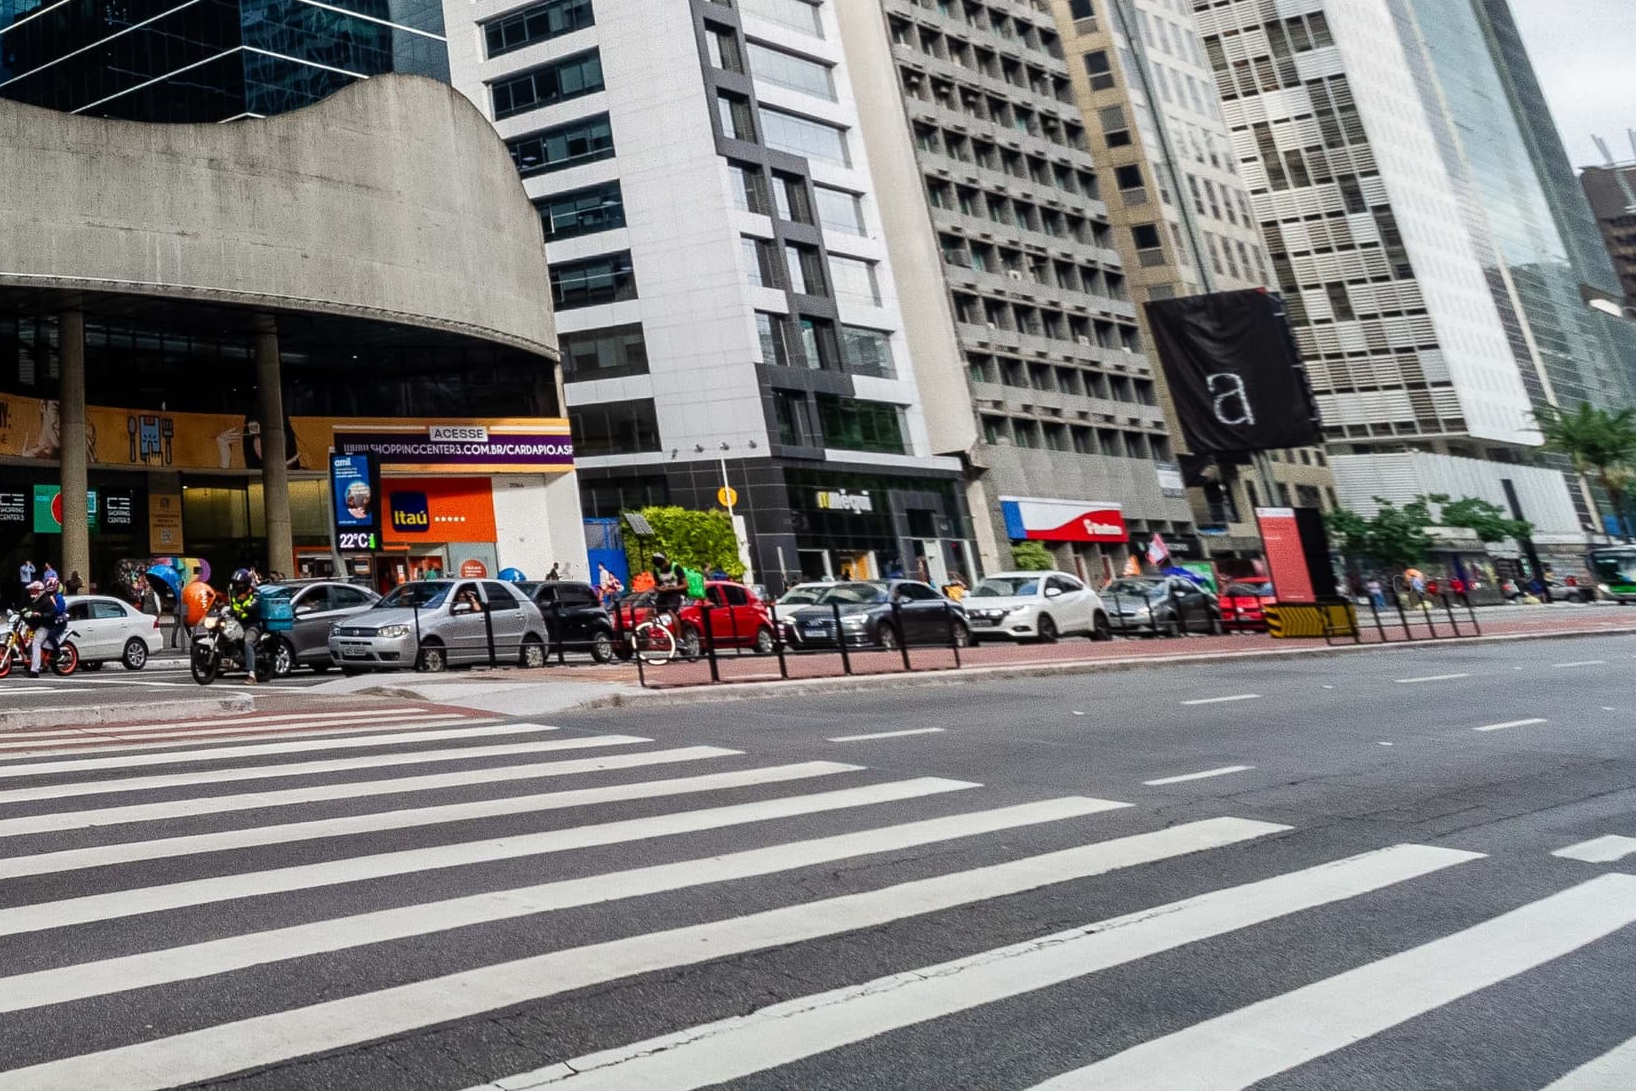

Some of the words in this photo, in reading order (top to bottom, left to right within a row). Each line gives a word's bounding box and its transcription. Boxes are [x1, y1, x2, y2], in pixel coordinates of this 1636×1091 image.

[1206, 372, 1255, 425] a
[434, 428, 484, 439] ACESSE
[394, 510, 428, 525] Itaú
